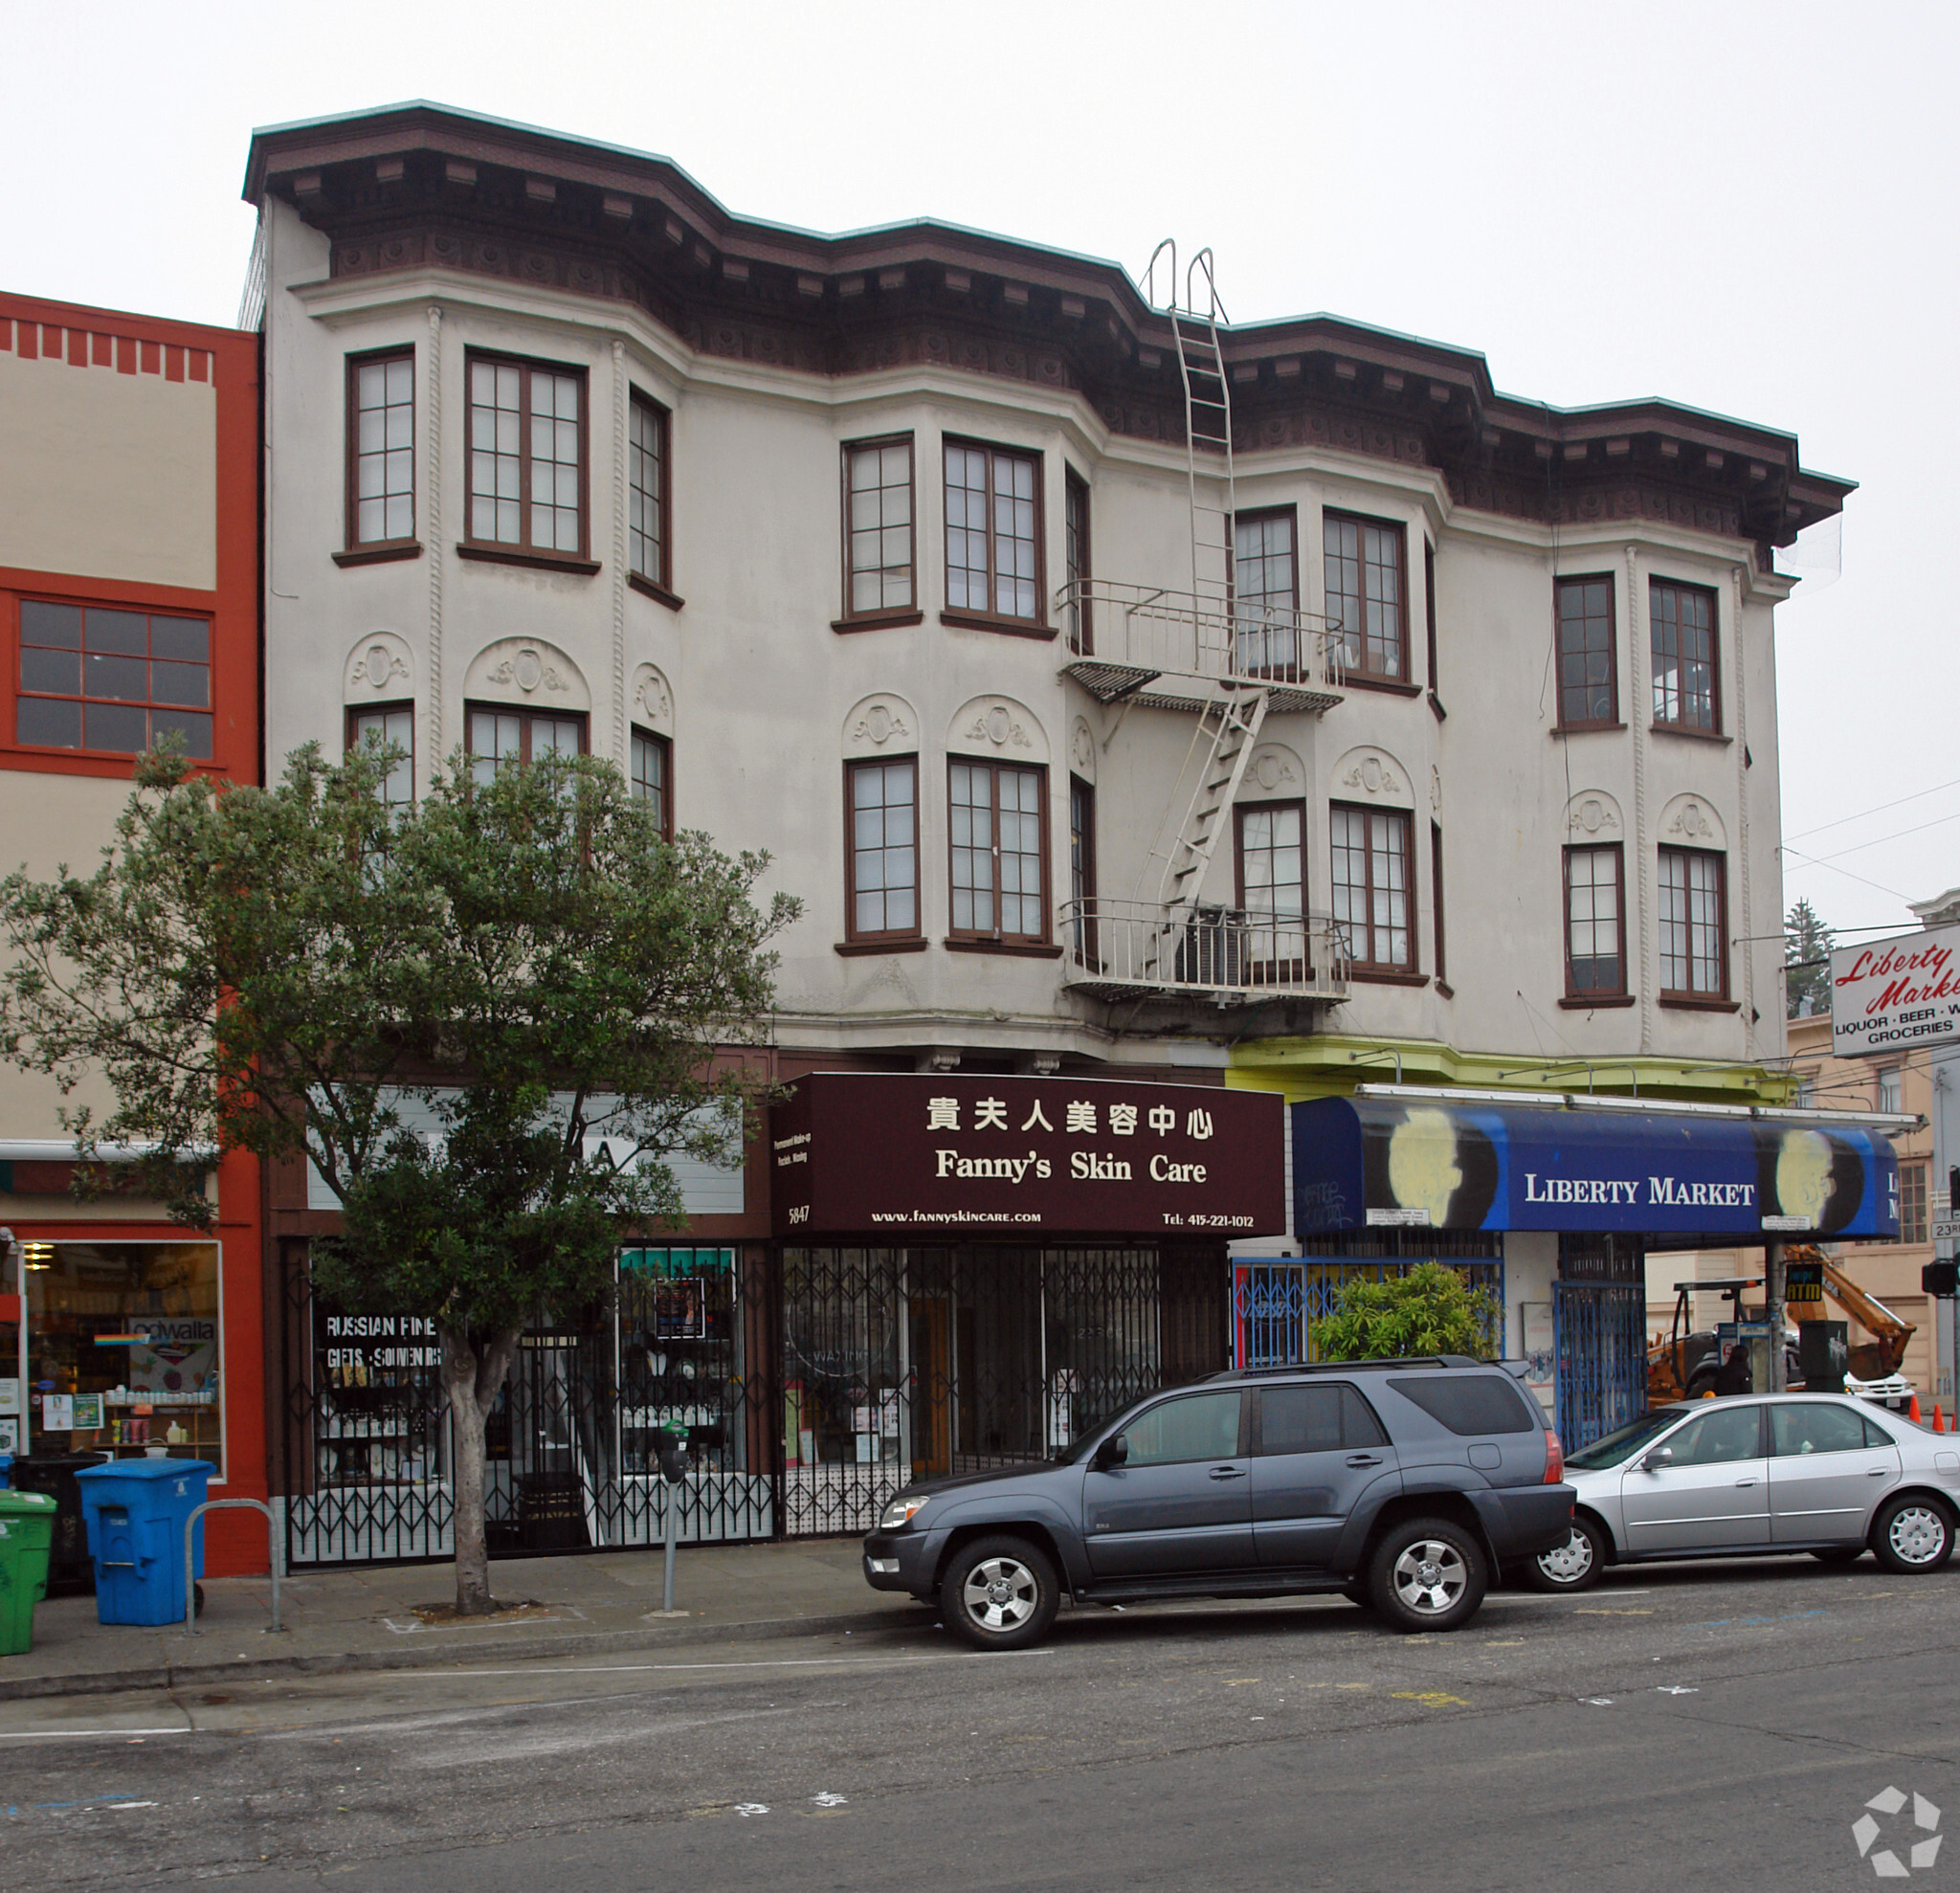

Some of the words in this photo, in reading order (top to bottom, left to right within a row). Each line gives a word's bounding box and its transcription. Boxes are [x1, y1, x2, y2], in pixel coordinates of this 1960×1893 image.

[1835, 944, 1952, 987] Liberty
[1836, 1016, 1888, 1036] LIQUOR
[1899, 1008, 1936, 1024] BEER
[1868, 1019, 1953, 1044] GROCERIES
[926, 1097, 1214, 1140] 貴夫人美容中心
[935, 1149, 1052, 1184] Fanny's
[1070, 1151, 1132, 1180] Skin
[1149, 1154, 1207, 1183] Care
[789, 1205, 811, 1224] 5847
[1188, 1214, 1254, 1228] 415-221-1012
[1786, 1283, 1821, 1301] ATM
[327, 1316, 394, 1337] RUSSIAN
[400, 1316, 437, 1336] FINE
[327, 1347, 363, 1369] GIFTS
